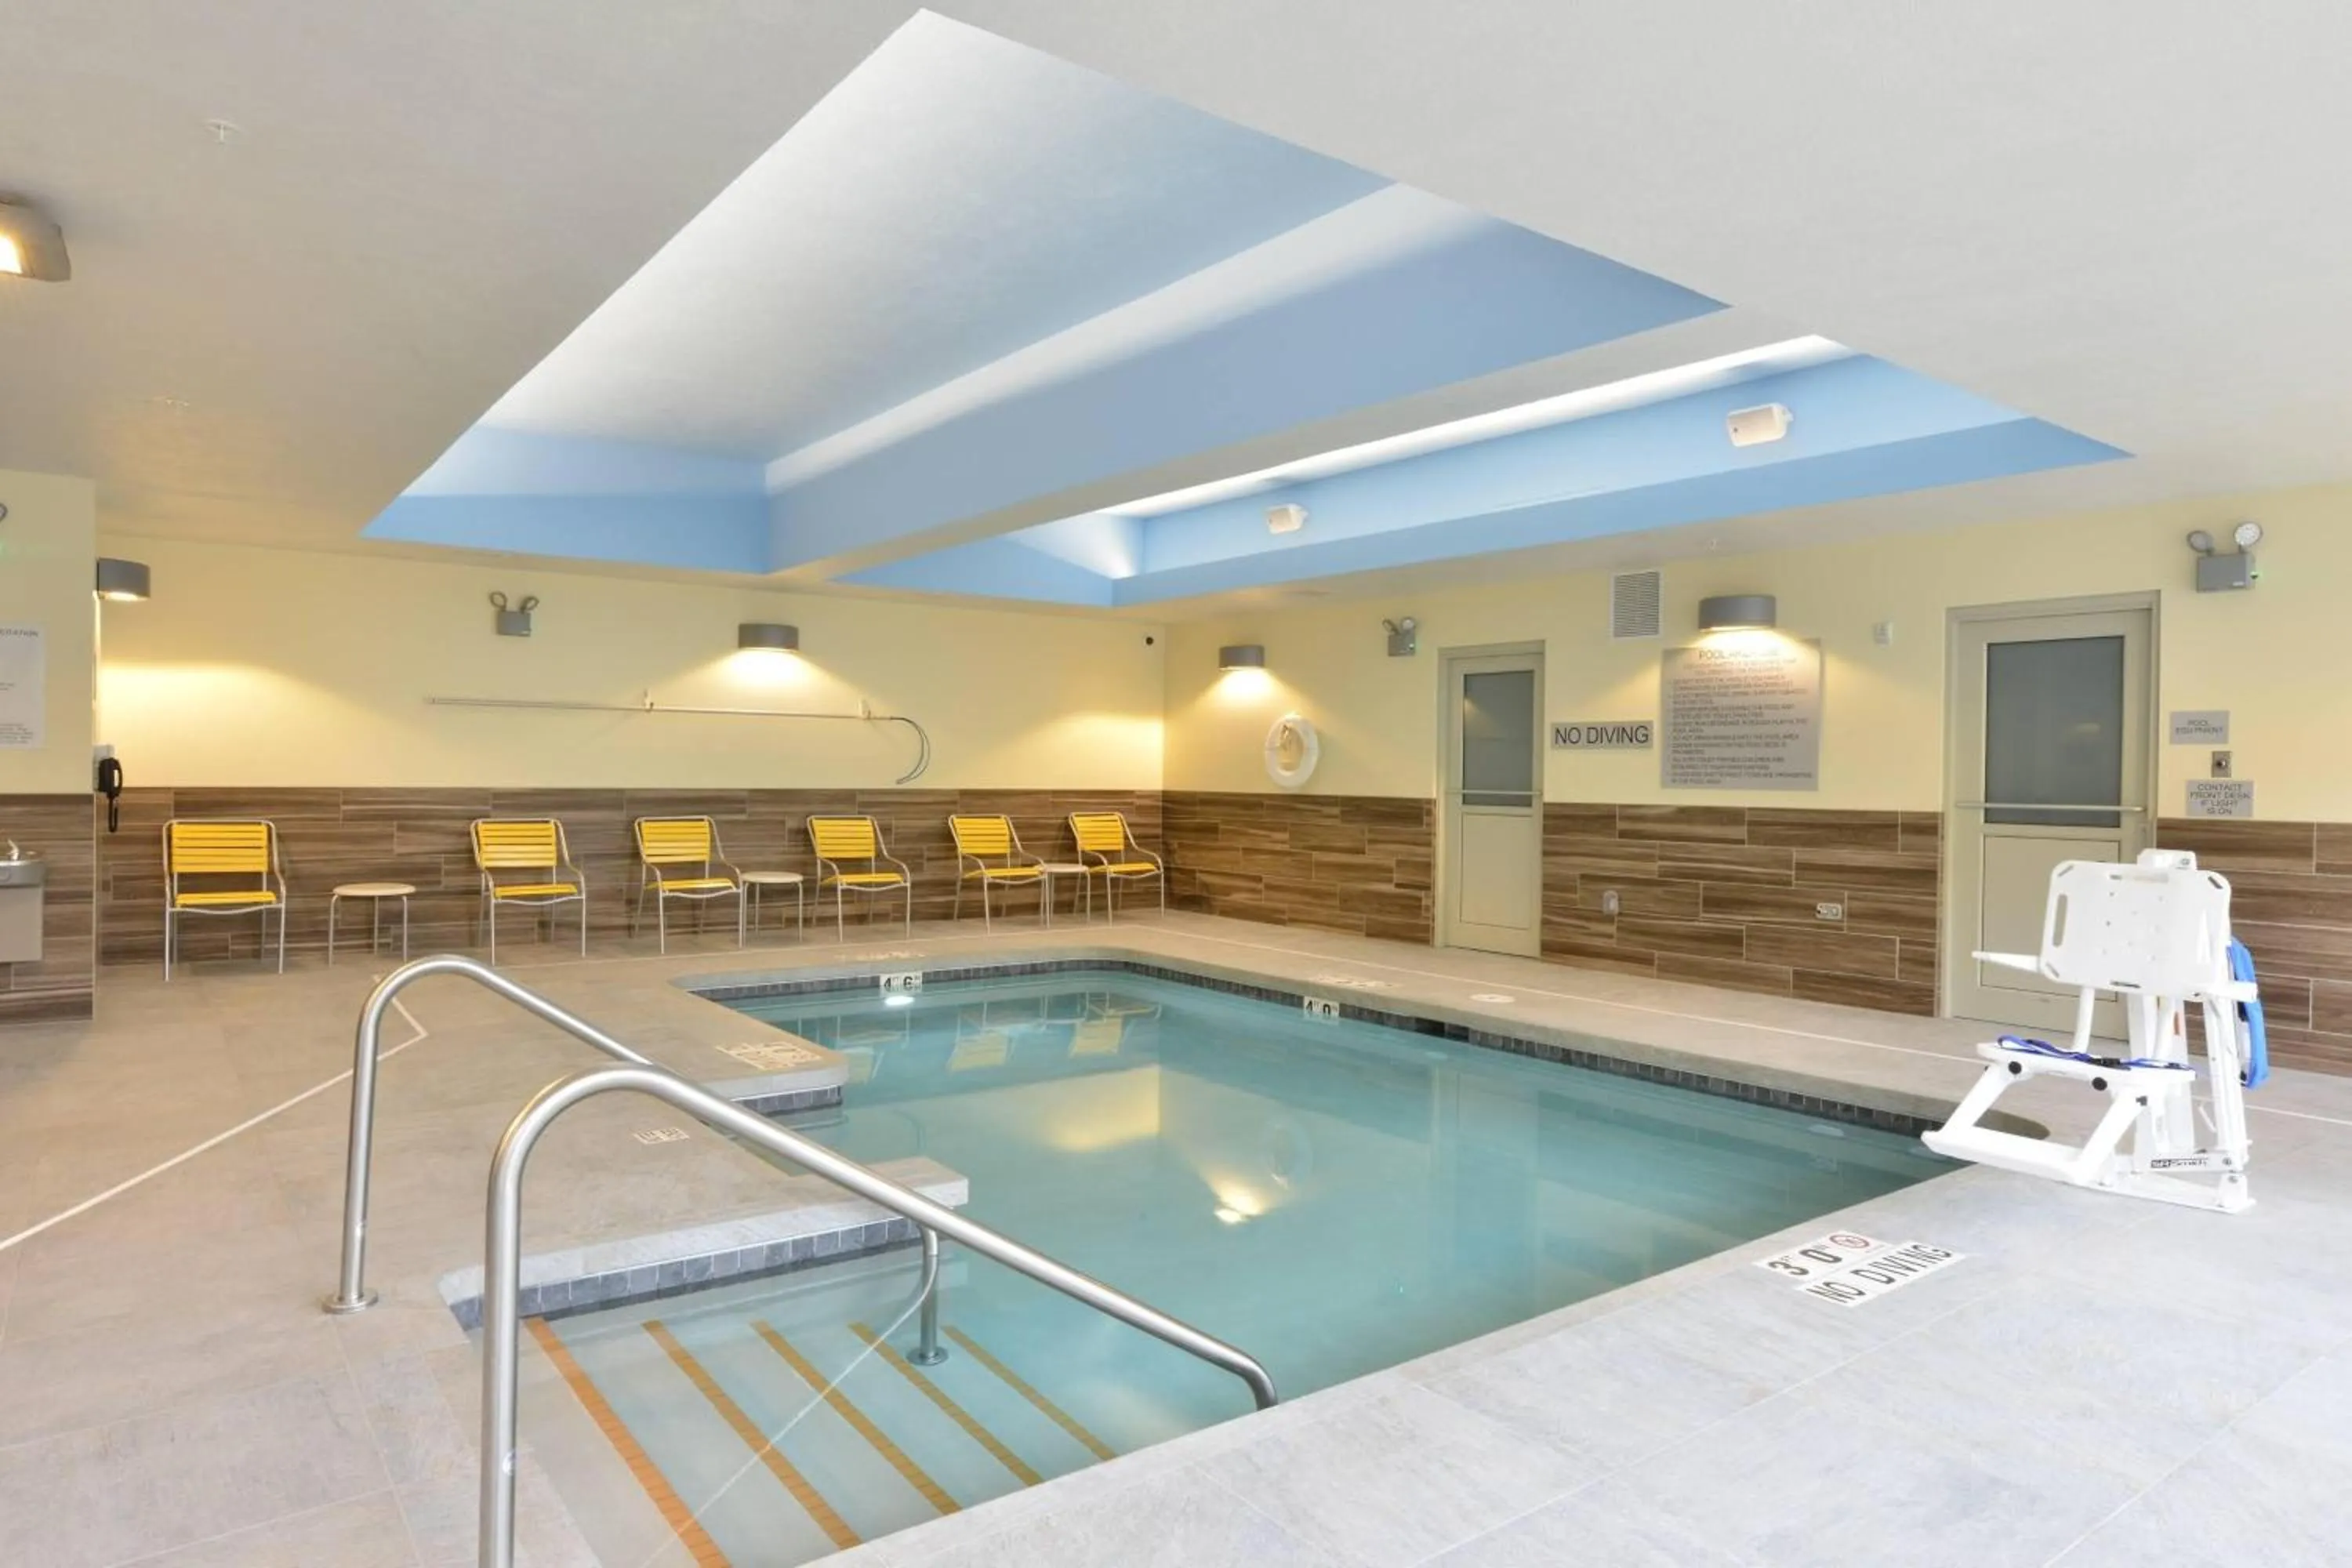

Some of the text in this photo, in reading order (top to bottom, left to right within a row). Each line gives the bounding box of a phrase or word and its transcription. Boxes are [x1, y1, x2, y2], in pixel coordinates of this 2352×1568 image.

[1555, 725, 1649, 744] NO DIVING
[1768, 1261, 1809, 1276] 3
[1799, 1249, 1843, 1264] 0
[1806, 1244, 1952, 1303] NO DIVING
